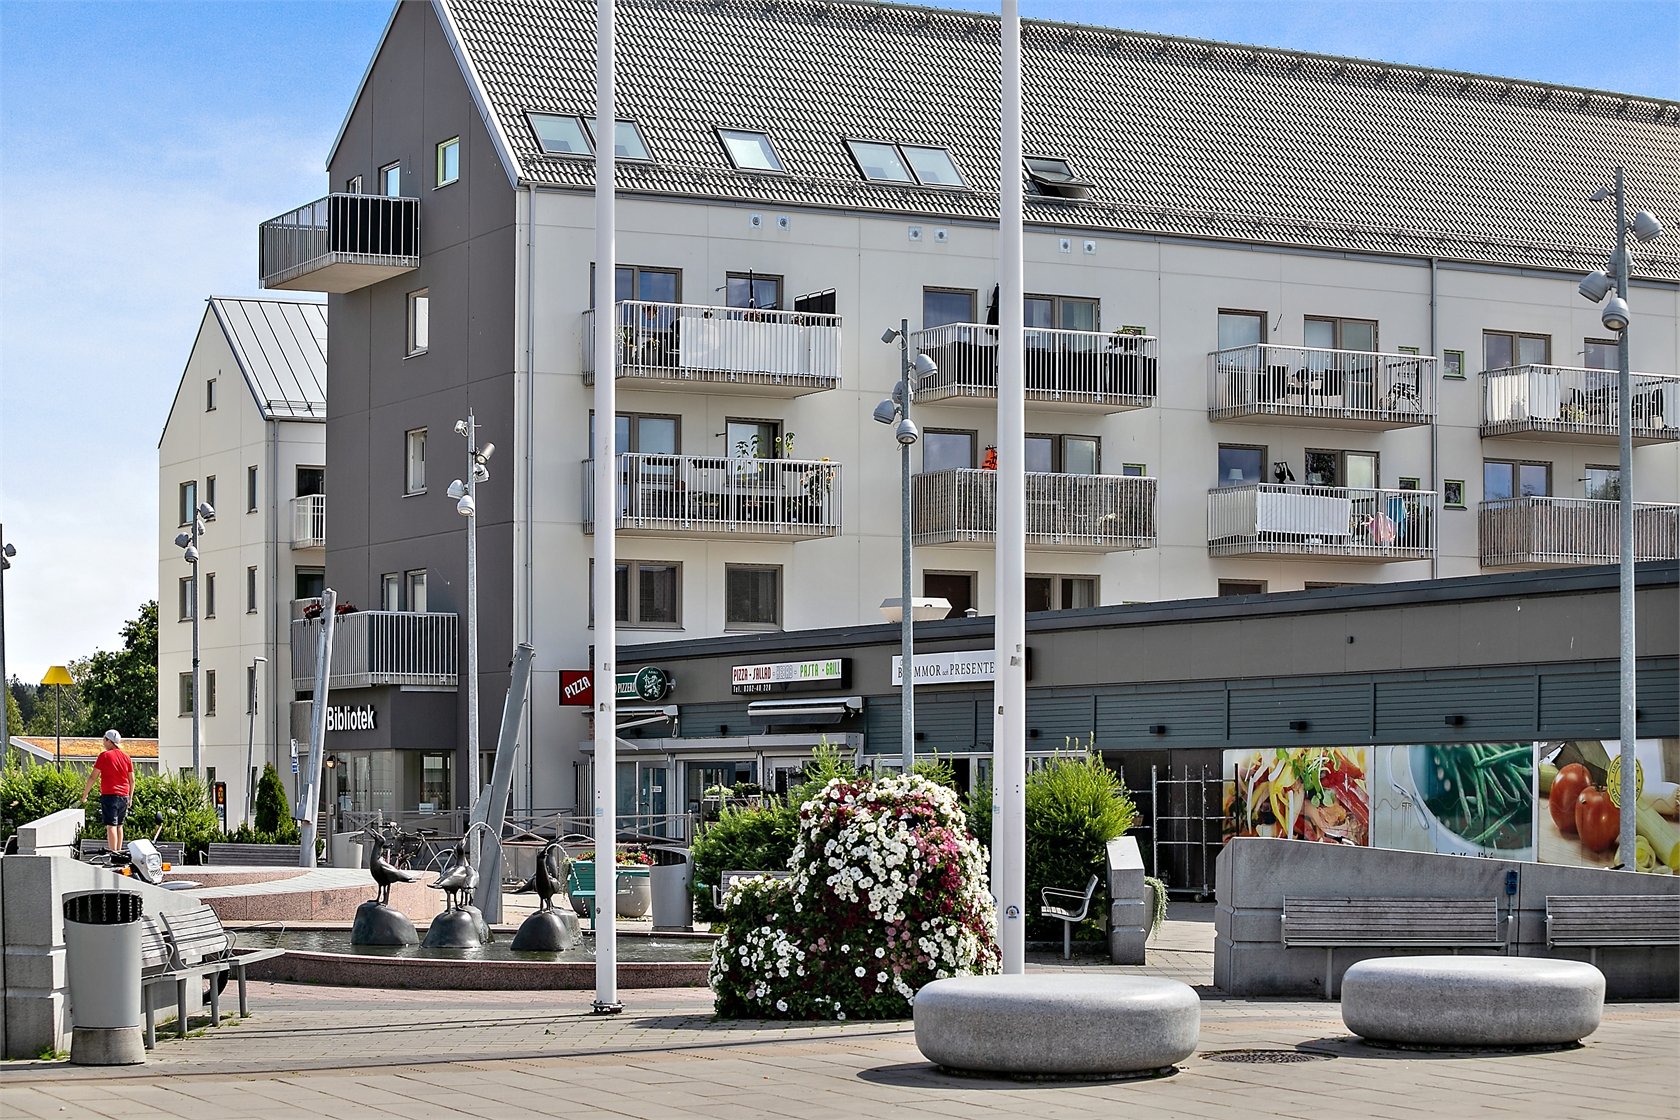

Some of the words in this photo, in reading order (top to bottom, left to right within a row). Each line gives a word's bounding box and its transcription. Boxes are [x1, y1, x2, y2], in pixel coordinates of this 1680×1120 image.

[734, 668, 748, 682] PIZZA
[753, 667, 771, 680] SALLAD
[800, 663, 819, 677] PASTA
[825, 661, 841, 676] GRILL
[898, 664, 941, 678] BMMOR
[949, 661, 995, 676] PRESENTE
[564, 676, 591, 699] PIZZA
[327, 704, 375, 731] Bibliotek
